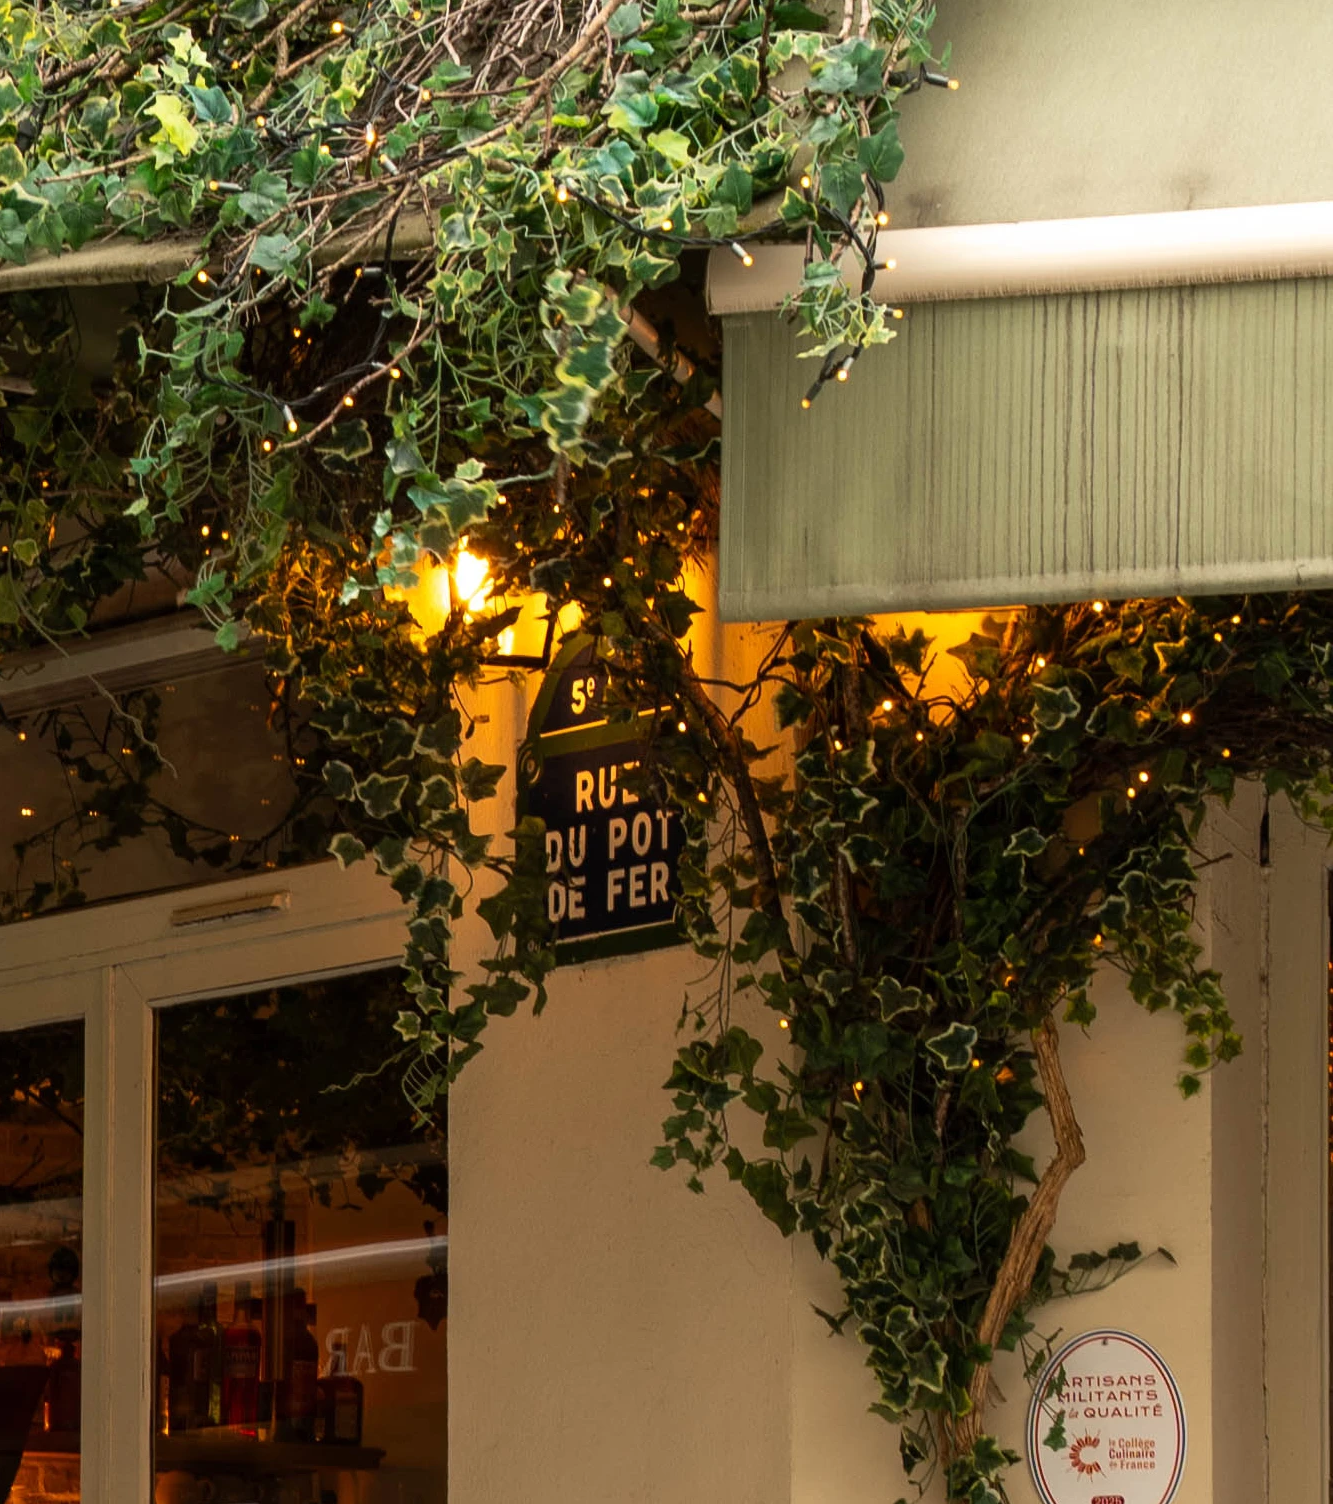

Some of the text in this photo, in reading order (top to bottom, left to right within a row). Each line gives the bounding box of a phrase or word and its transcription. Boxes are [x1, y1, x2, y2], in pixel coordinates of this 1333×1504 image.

[545, 810, 675, 873] DU POT
[548, 862, 670, 924] DE FER
[1057, 1389, 1159, 1403] MILITANTS
[1083, 1403, 1164, 1419] QUALITÉ
[1118, 1437, 1156, 1449] Collège
[1108, 1448, 1156, 1459] Culinaire
[1120, 1460, 1156, 1470] France
